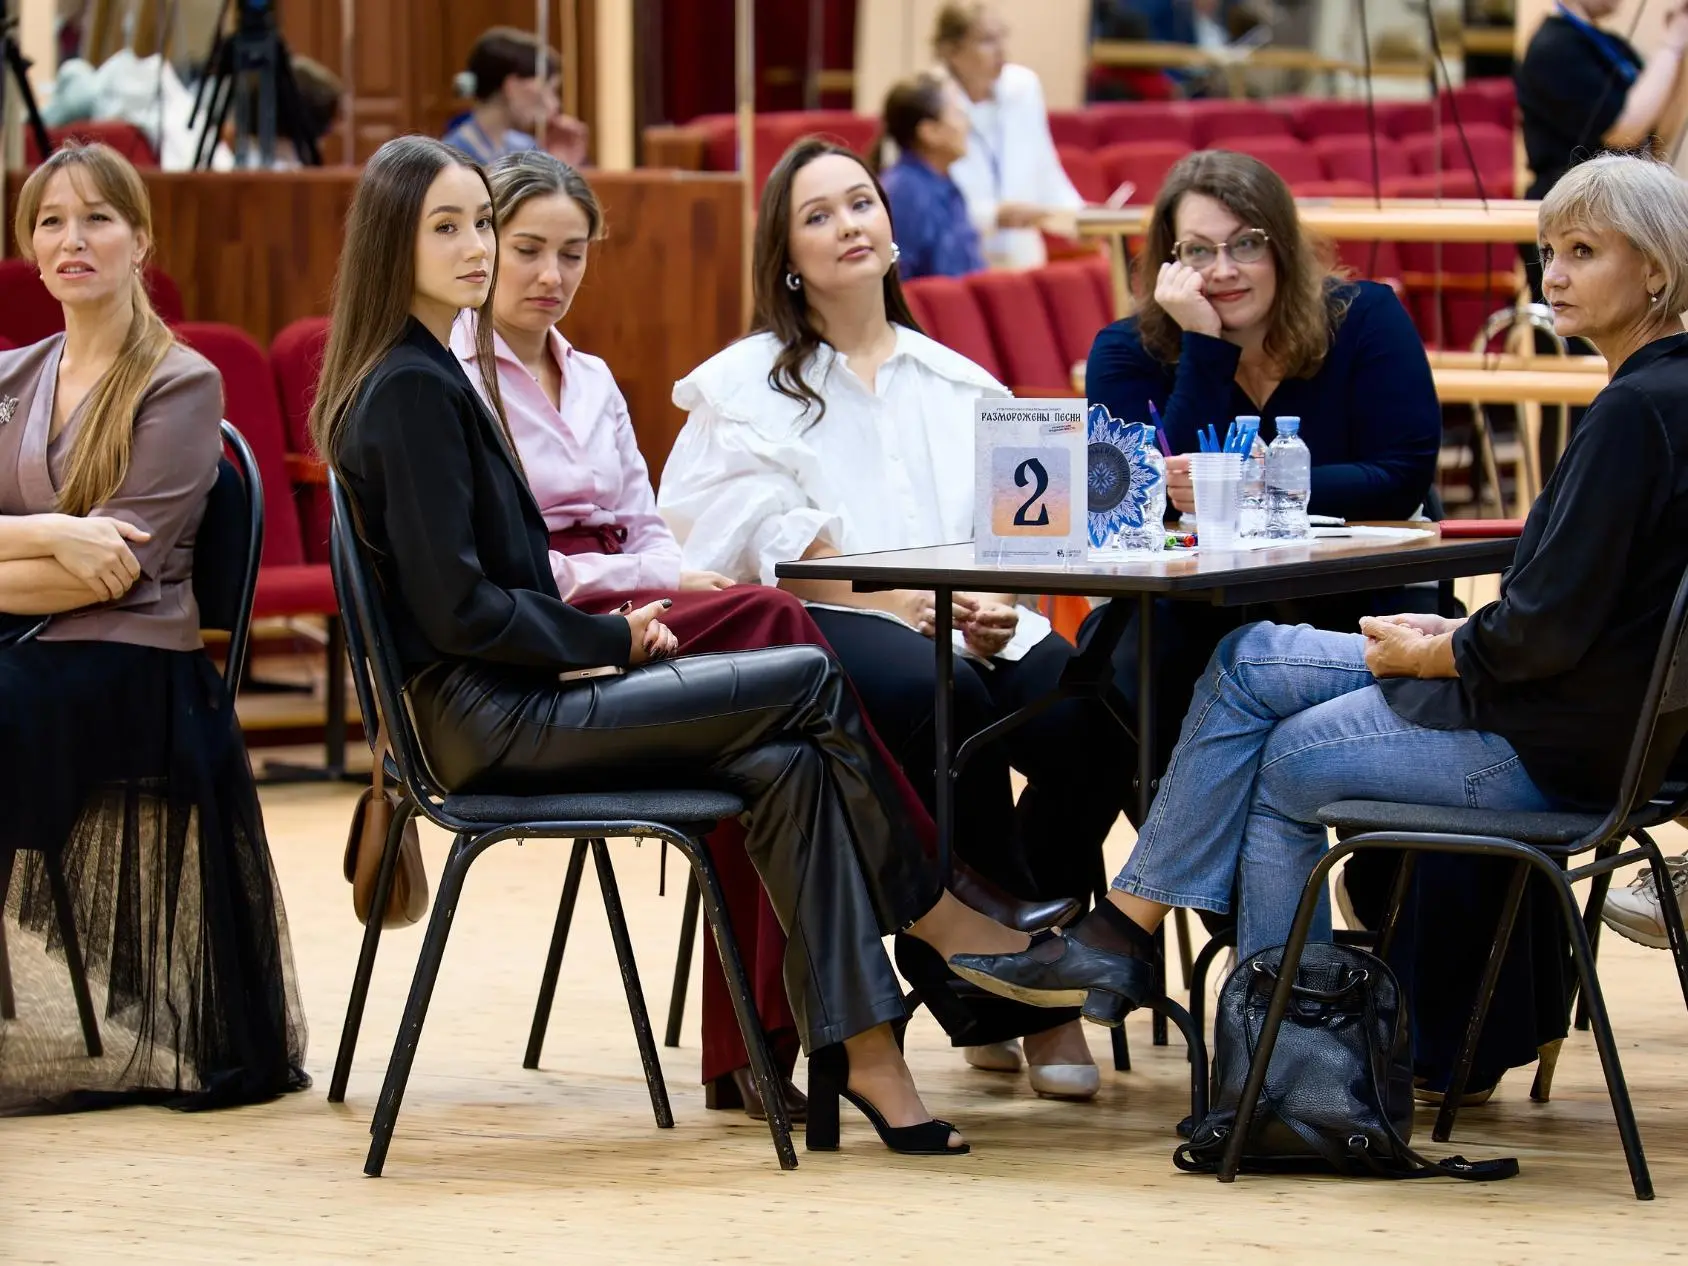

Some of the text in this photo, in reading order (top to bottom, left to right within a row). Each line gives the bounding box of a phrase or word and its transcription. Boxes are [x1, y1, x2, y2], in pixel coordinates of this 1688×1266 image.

[981, 412, 1081, 422] РАЗМОРОЖЕНЫ ПЕСНИ
[1013, 457, 1049, 526] 2
